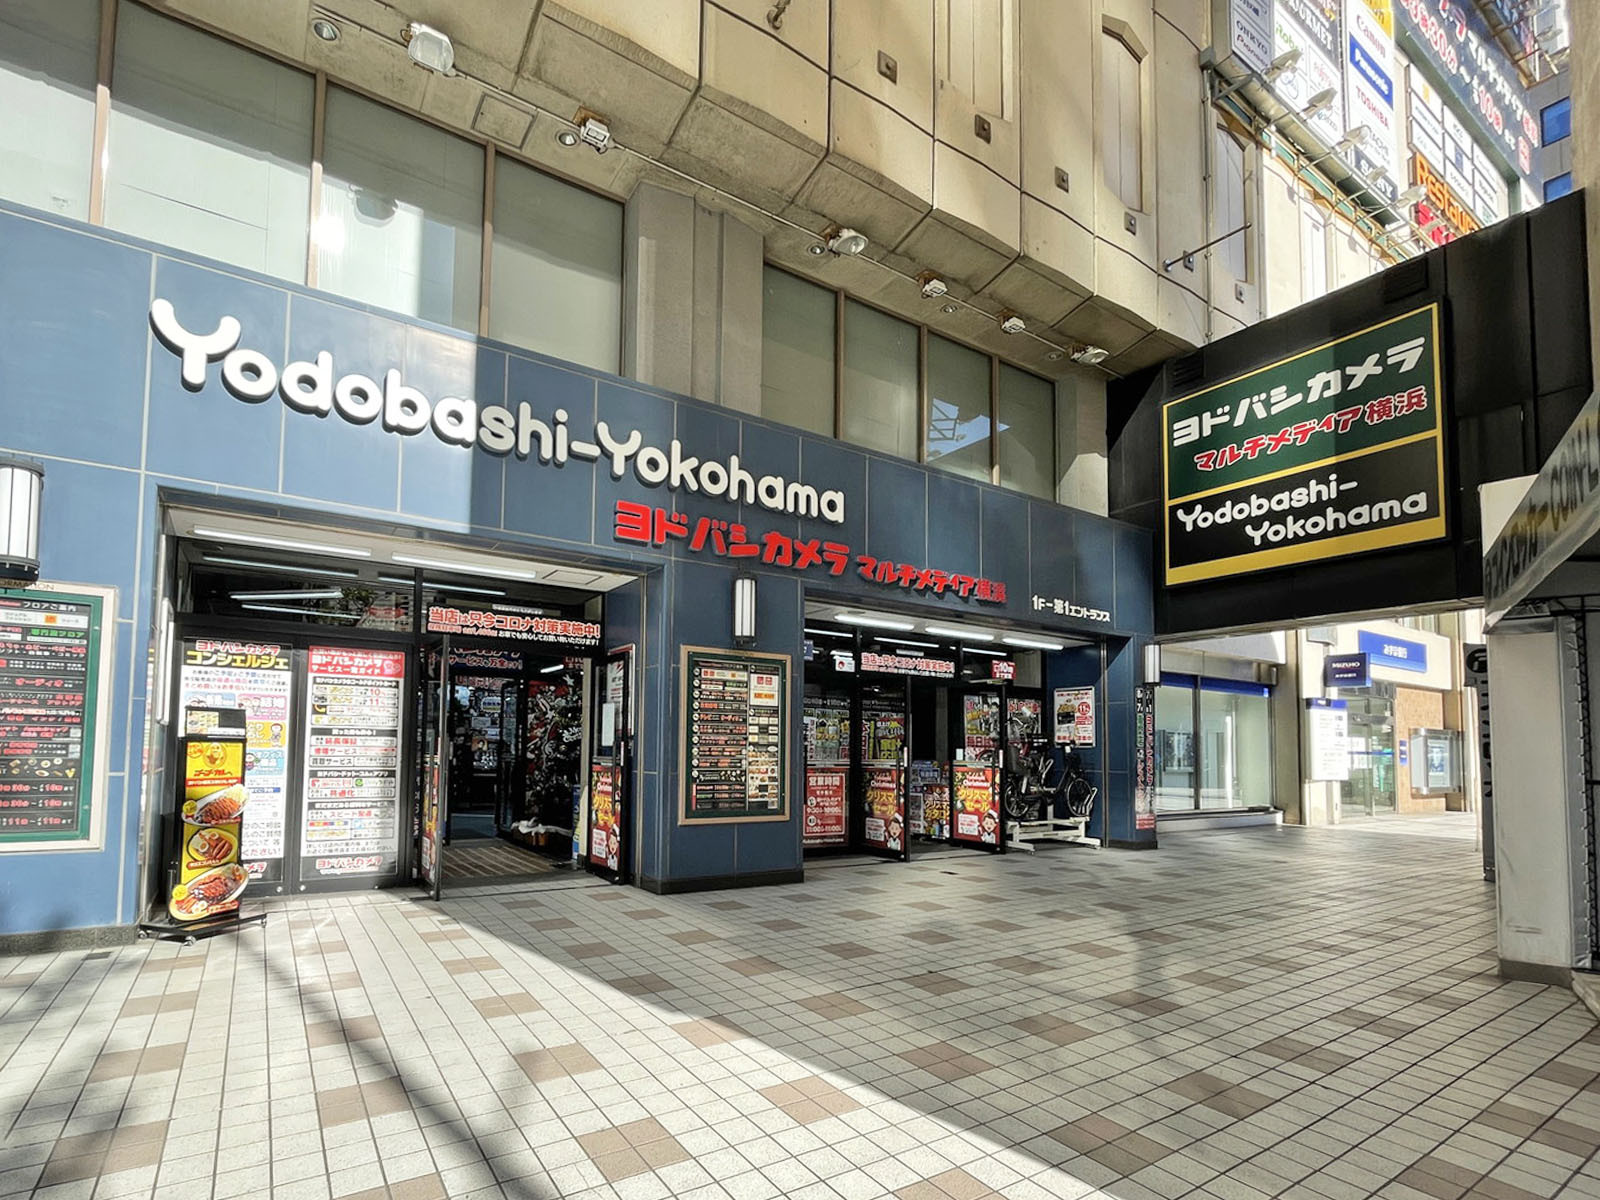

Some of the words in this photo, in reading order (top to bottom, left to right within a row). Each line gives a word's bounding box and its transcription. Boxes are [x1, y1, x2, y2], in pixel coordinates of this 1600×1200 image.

[1236, 20, 1268, 55] ONKYO
[1354, 47, 1389, 96] Panasonic
[1356, 85, 1389, 129] TOSHIBA
[150, 298, 846, 523] Yodobashi-Yokohama
[1173, 337, 1425, 447] ヨドバシカメラ
[1194, 385, 1427, 471] マルチメディア横浜
[1176, 473, 1358, 532] Yodobashi-
[1244, 491, 1427, 546] Yokohama
[614, 500, 851, 577] ヨドバシカメラ
[856, 554, 1007, 604] マルチメディア横浜
[195, 640, 282, 656] ヨドバシカメラ
[312, 655, 383, 668] ヨドバシカメラ
[1332, 661, 1360, 669] MIZUHO
